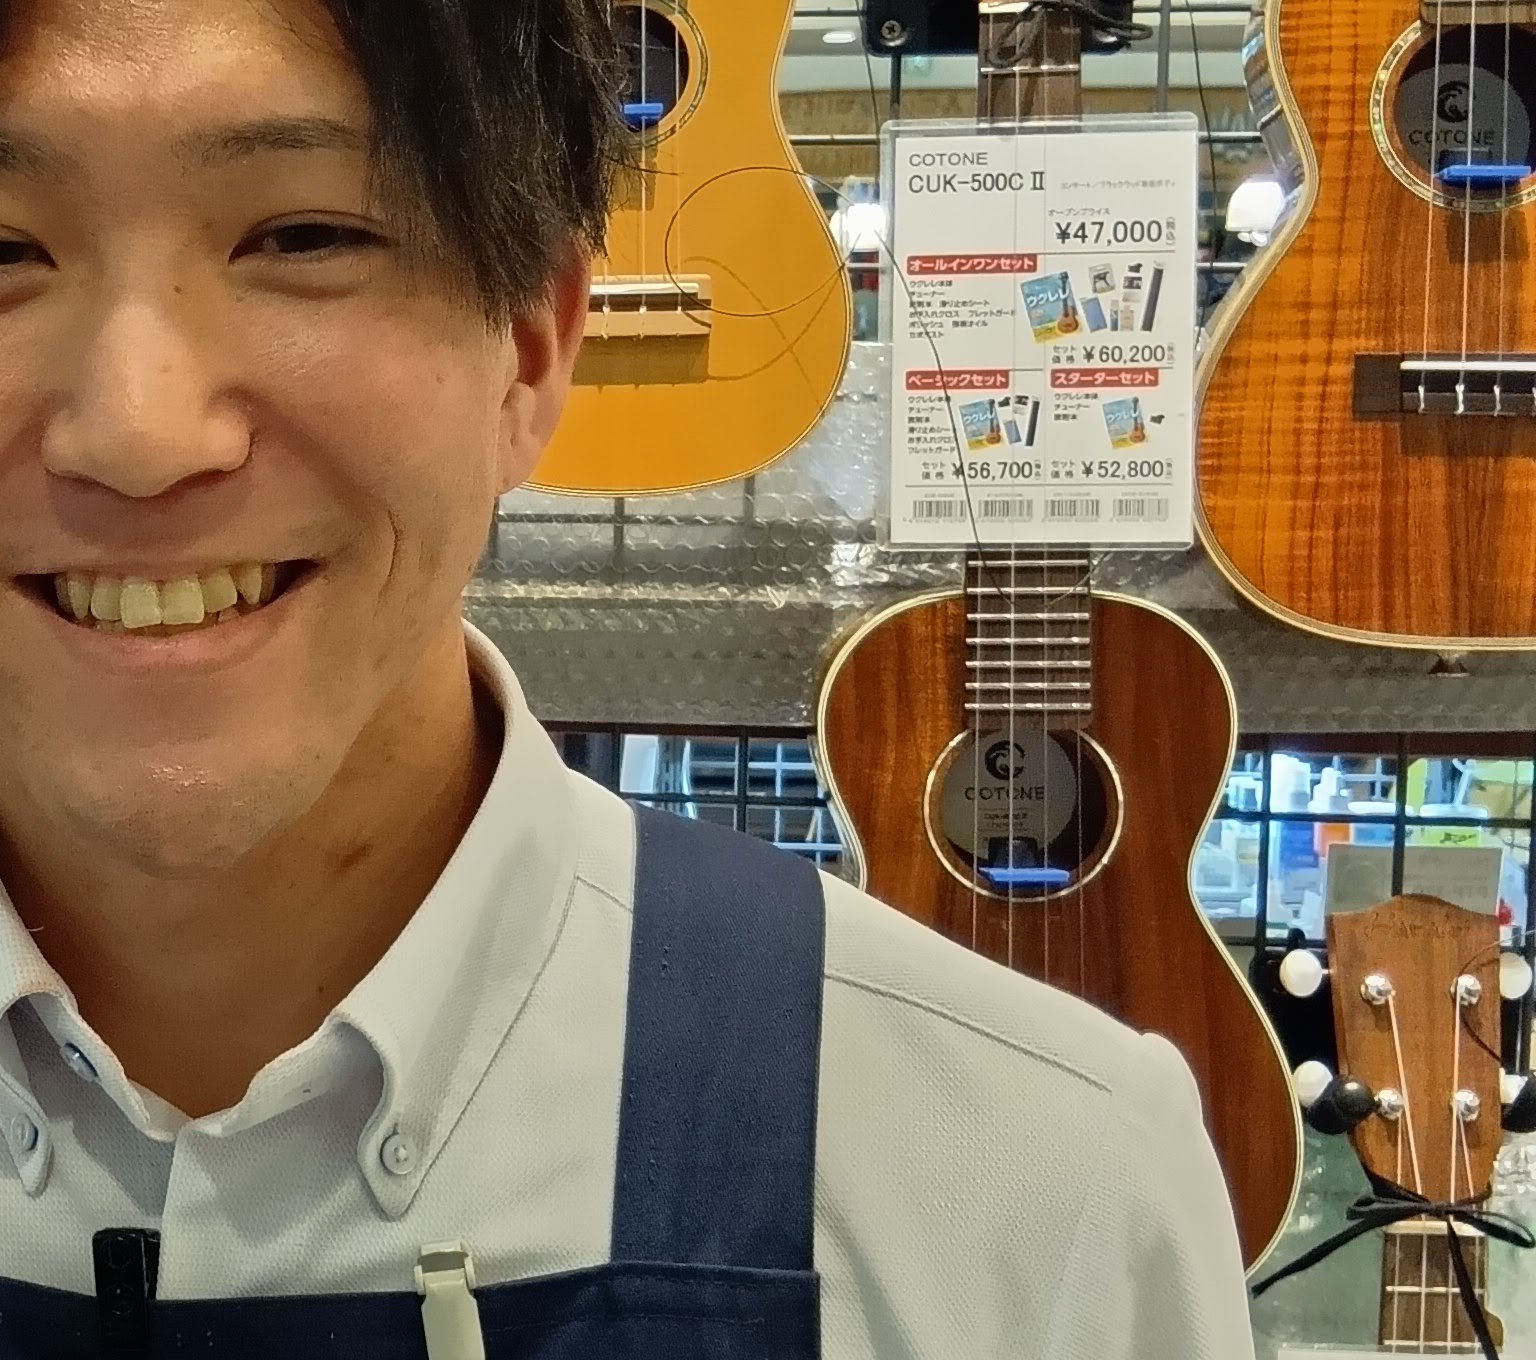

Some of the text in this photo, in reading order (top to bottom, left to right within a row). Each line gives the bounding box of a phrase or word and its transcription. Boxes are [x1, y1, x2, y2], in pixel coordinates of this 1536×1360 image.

[909, 152, 988, 166] COTONE
[1056, 220, 1162, 247] ¥47,000
[910, 257, 1034, 272] オールインワンセット
[1026, 287, 1070, 307] ウクレレ
[1082, 345, 1165, 364] ¥60,200
[908, 372, 1007, 387] ベーシックセット
[1055, 370, 1155, 385] スターターセット
[951, 462, 1033, 481] ¥56,700
[1082, 461, 1164, 480] ¥52,800
[964, 786, 1045, 801] COTONE
